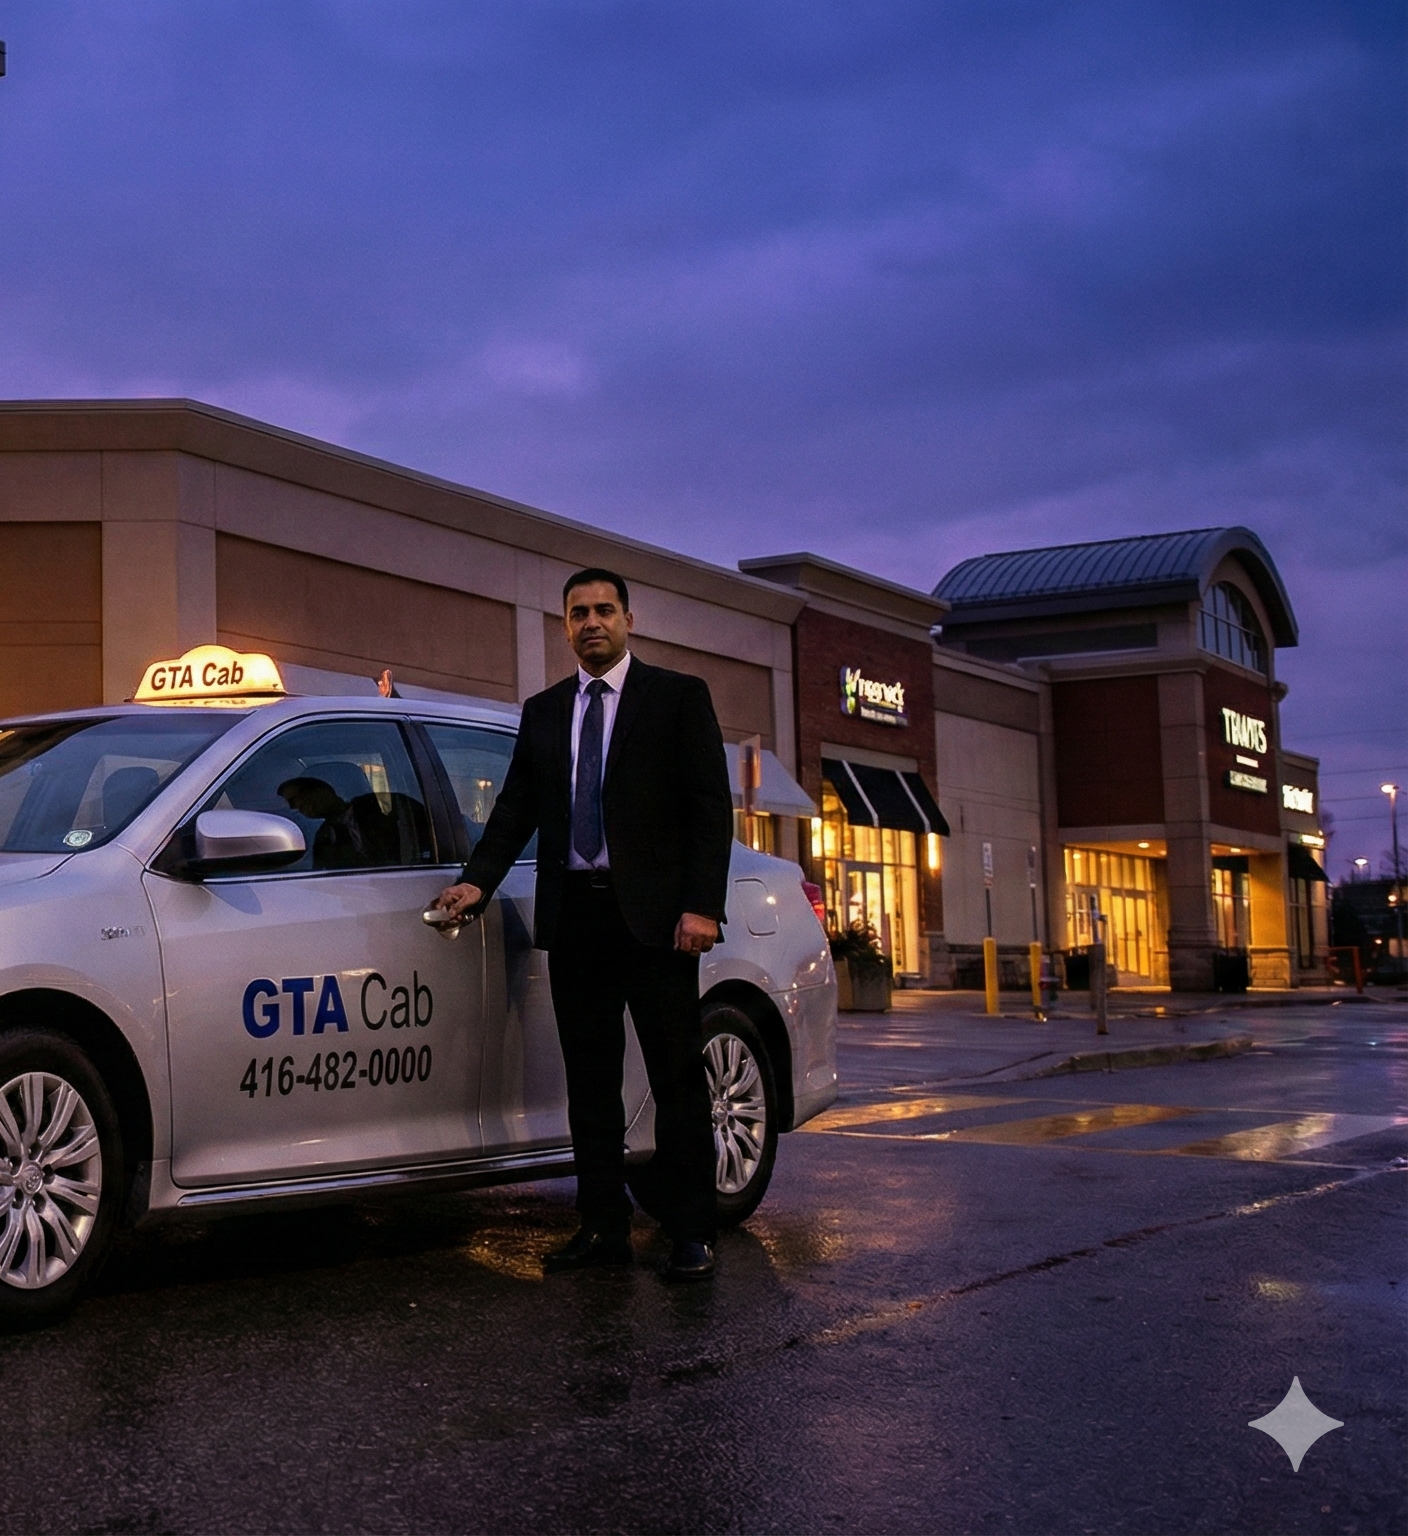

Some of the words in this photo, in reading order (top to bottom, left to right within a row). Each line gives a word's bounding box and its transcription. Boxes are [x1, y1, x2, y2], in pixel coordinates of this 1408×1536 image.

[151, 665, 193, 690] GTA
[202, 661, 243, 686] Cab
[242, 974, 349, 1039] GTA
[361, 970, 433, 1030] Cab
[239, 1044, 432, 1098] 416-482-0000
